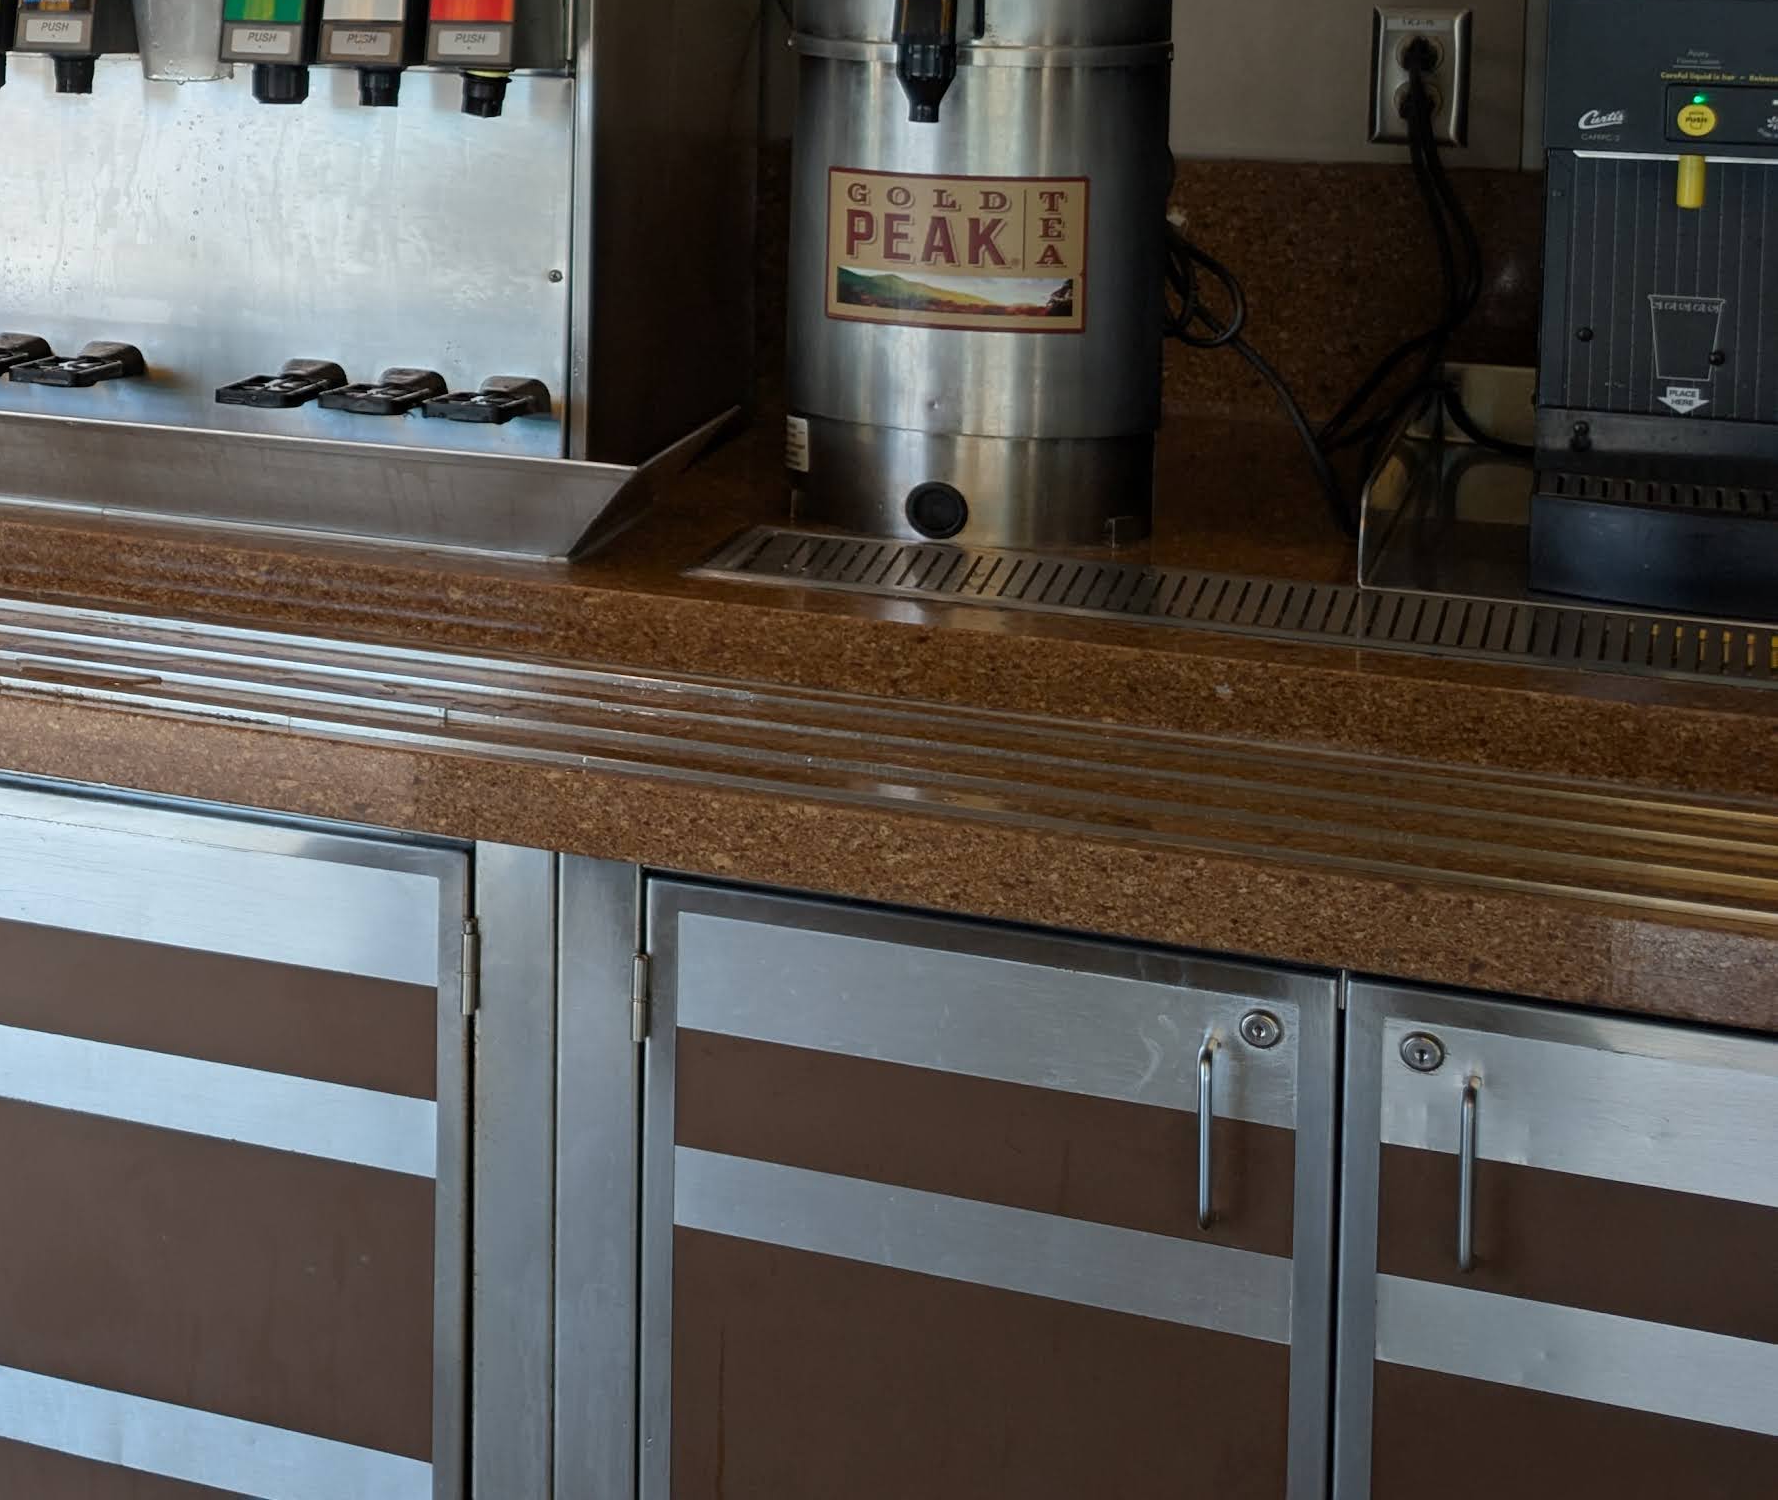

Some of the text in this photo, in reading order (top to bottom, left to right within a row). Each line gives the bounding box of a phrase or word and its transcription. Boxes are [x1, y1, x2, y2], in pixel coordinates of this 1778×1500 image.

[40, 22, 69, 33] PUSH
[247, 32, 277, 42] PUSH
[454, 33, 486, 44] PUSH
[1660, 71, 1688, 80] Careful
[1689, 72, 1712, 81] liquid
[1578, 109, 1624, 130] Curtis
[847, 182, 1012, 213] GOLD
[1036, 190, 1067, 268] TEA
[845, 208, 1011, 269] PEAK
[1669, 389, 1697, 398] PLACE
[1671, 398, 1695, 406] HERE
